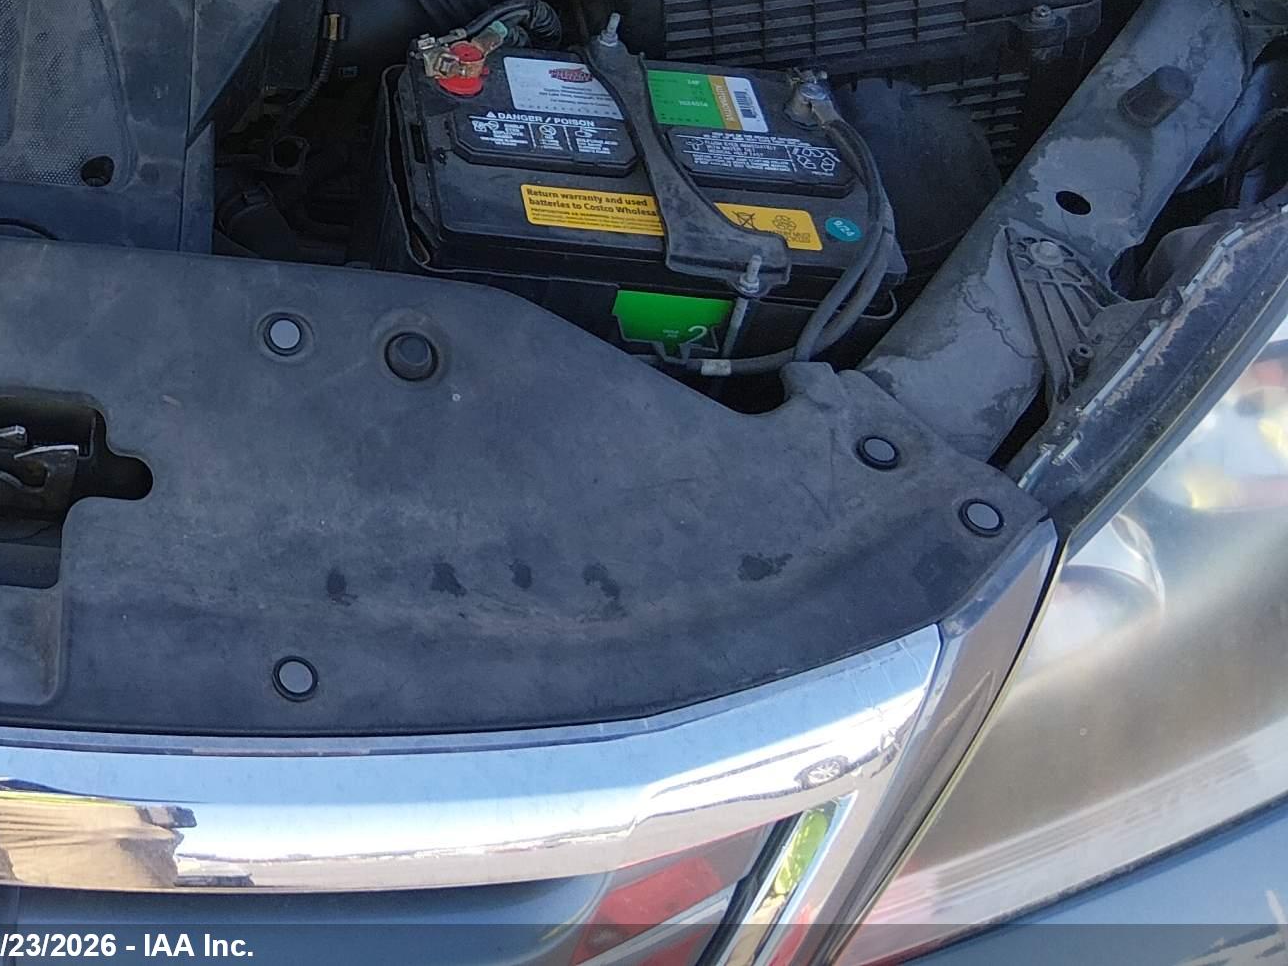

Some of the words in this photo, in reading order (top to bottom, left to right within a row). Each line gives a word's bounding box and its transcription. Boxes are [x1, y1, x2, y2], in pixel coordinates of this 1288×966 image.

[497, 113, 543, 122] DANGER
[554, 117, 595, 127] POISON
[527, 189, 559, 198] Return
[561, 192, 602, 204] warranty
[606, 195, 623, 204] and
[625, 198, 648, 206] used
[529, 197, 570, 208] batteries
[584, 203, 614, 213] Costco
[616, 207, 656, 216] Wholesa
